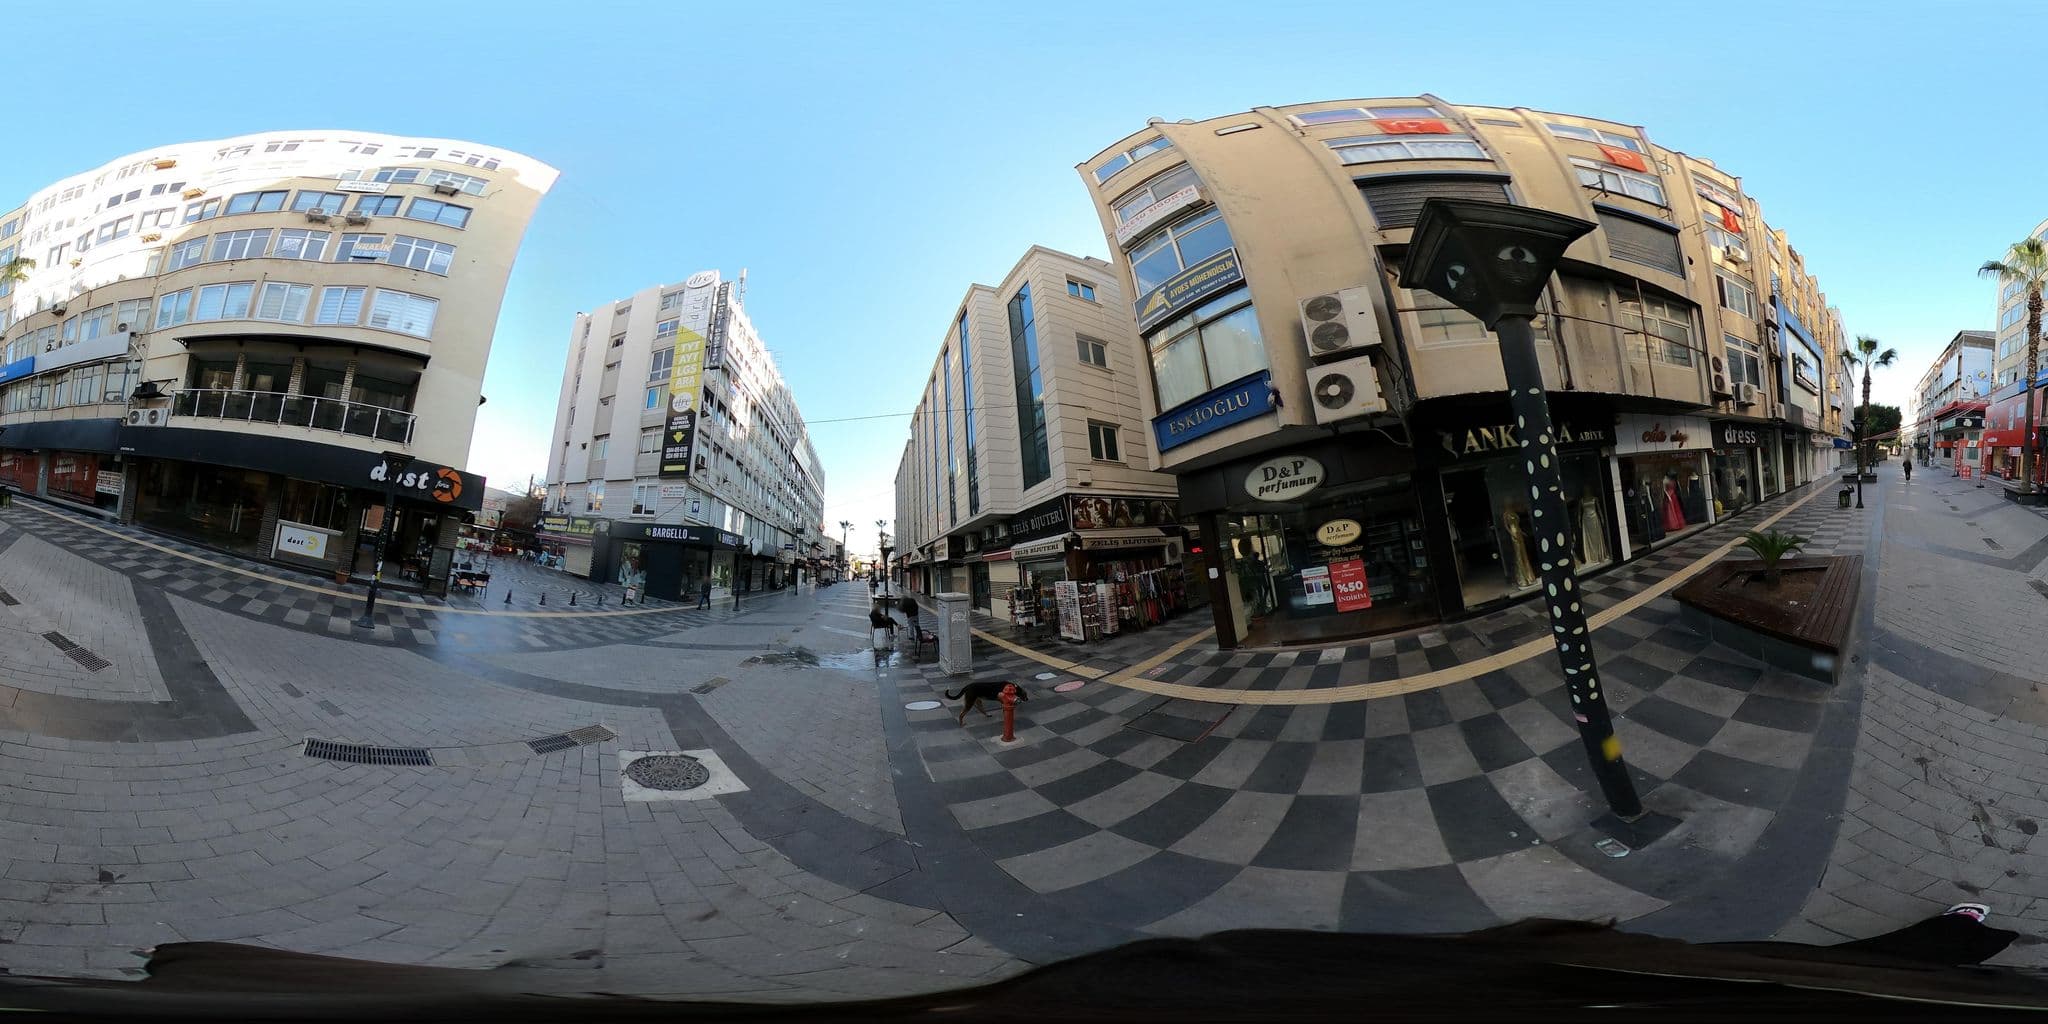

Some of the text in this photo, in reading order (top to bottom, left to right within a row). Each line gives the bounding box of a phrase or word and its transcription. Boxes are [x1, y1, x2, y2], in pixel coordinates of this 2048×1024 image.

[1170, 259, 1234, 298] AYDES MÜHENDİSLİK
[680, 342, 700, 352] TYT
[679, 352, 698, 363] AYT
[677, 364, 697, 375] LGS
[1169, 390, 1250, 435] ESKİOĞLU
[1464, 422, 1574, 454] ANKA
[1725, 425, 1757, 444] dress
[370, 460, 429, 489] dst
[1258, 475, 1317, 496] perfumum
[1030, 506, 1064, 531] BİJUTERİ
[287, 536, 304, 545] dost
[652, 527, 688, 539] BARGELLO
[1337, 580, 1364, 594] %50
